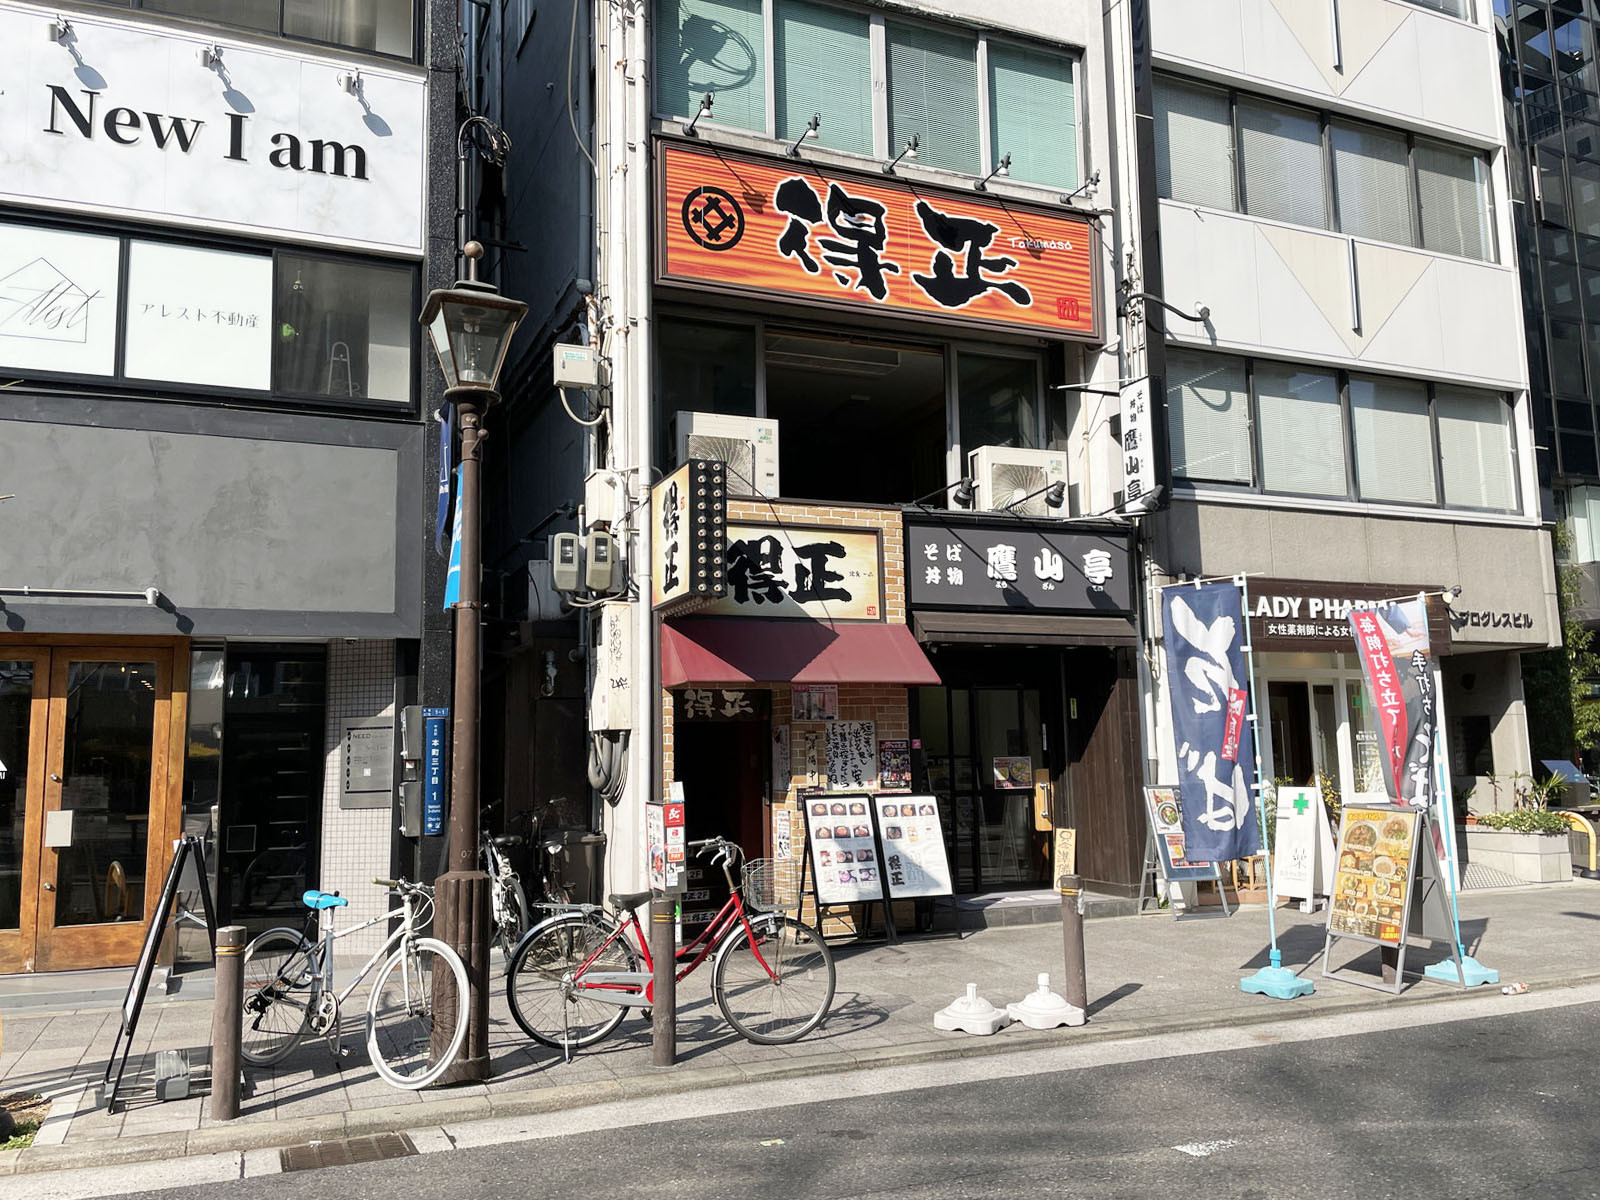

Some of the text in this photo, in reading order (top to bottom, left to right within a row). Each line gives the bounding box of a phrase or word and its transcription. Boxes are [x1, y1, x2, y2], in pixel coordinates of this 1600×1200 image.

[43, 84, 370, 181] New I am
[773, 176, 1034, 308] 得正
[140, 302, 261, 329] アレスト不動産
[1124, 428, 1142, 501] 鷹山亭
[727, 535, 852, 604] 得正
[924, 543, 963, 562] そば
[986, 543, 1114, 585] 鷹山亭
[925, 567, 964, 586] 丼物
[1241, 596, 1302, 619] LADY
[1458, 611, 1533, 629] プログレスビル
[1268, 623, 1354, 638] 女性薬剤師による女
[431, 739, 440, 785] 本町三丁目
